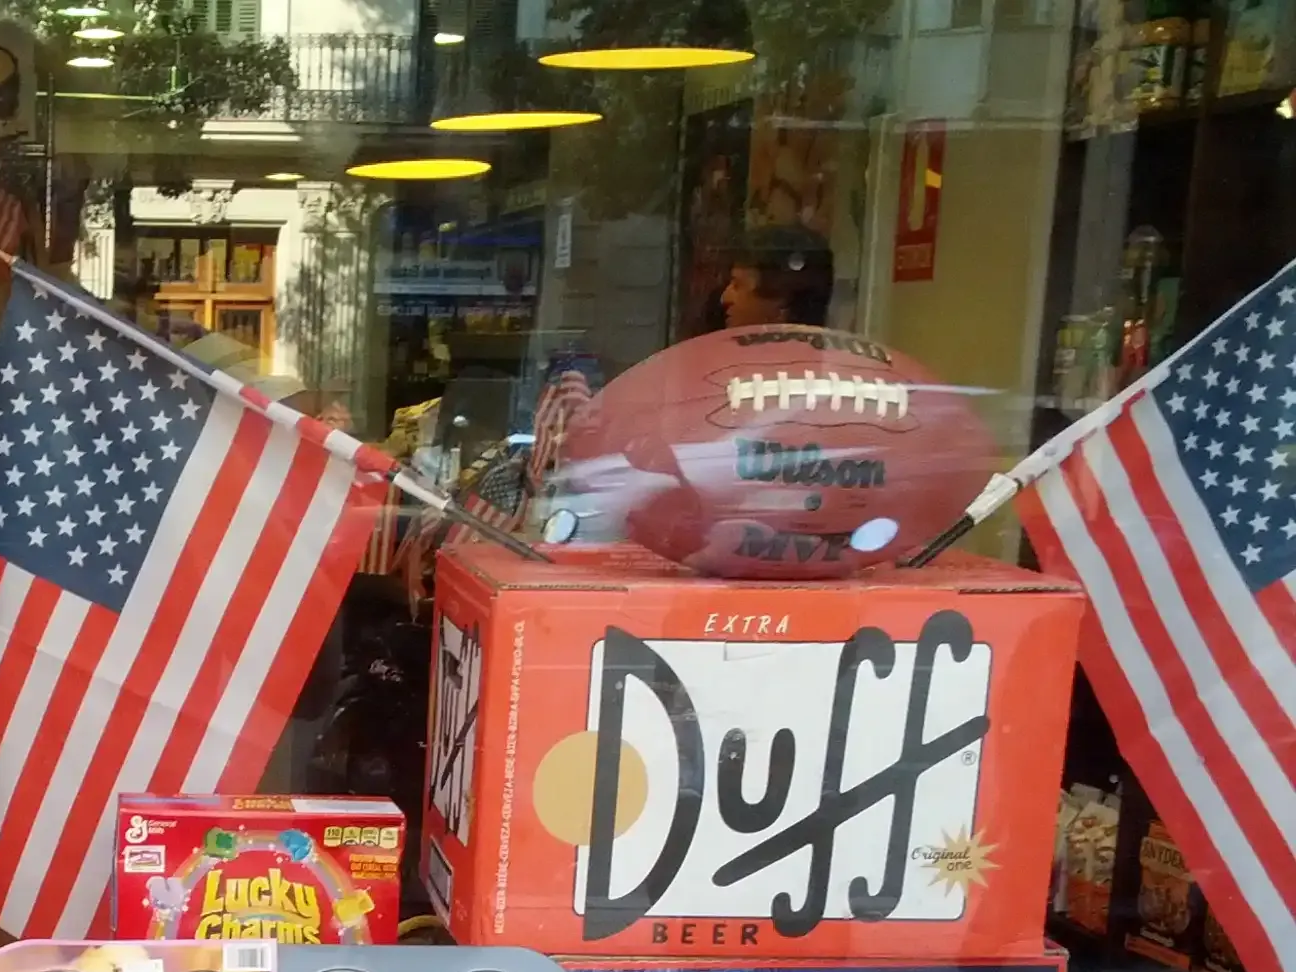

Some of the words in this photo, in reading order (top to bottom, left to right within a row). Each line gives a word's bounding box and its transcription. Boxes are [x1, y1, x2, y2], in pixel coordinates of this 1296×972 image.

[734, 436, 885, 489] Wilson
[704, 612, 792, 635] EXTRA
[582, 608, 992, 941] Duff
[911, 845, 971, 865] Original
[946, 860, 973, 872] one
[200, 868, 317, 918] Lucky
[195, 913, 322, 944] Charms
[651, 921, 760, 945] BEER
